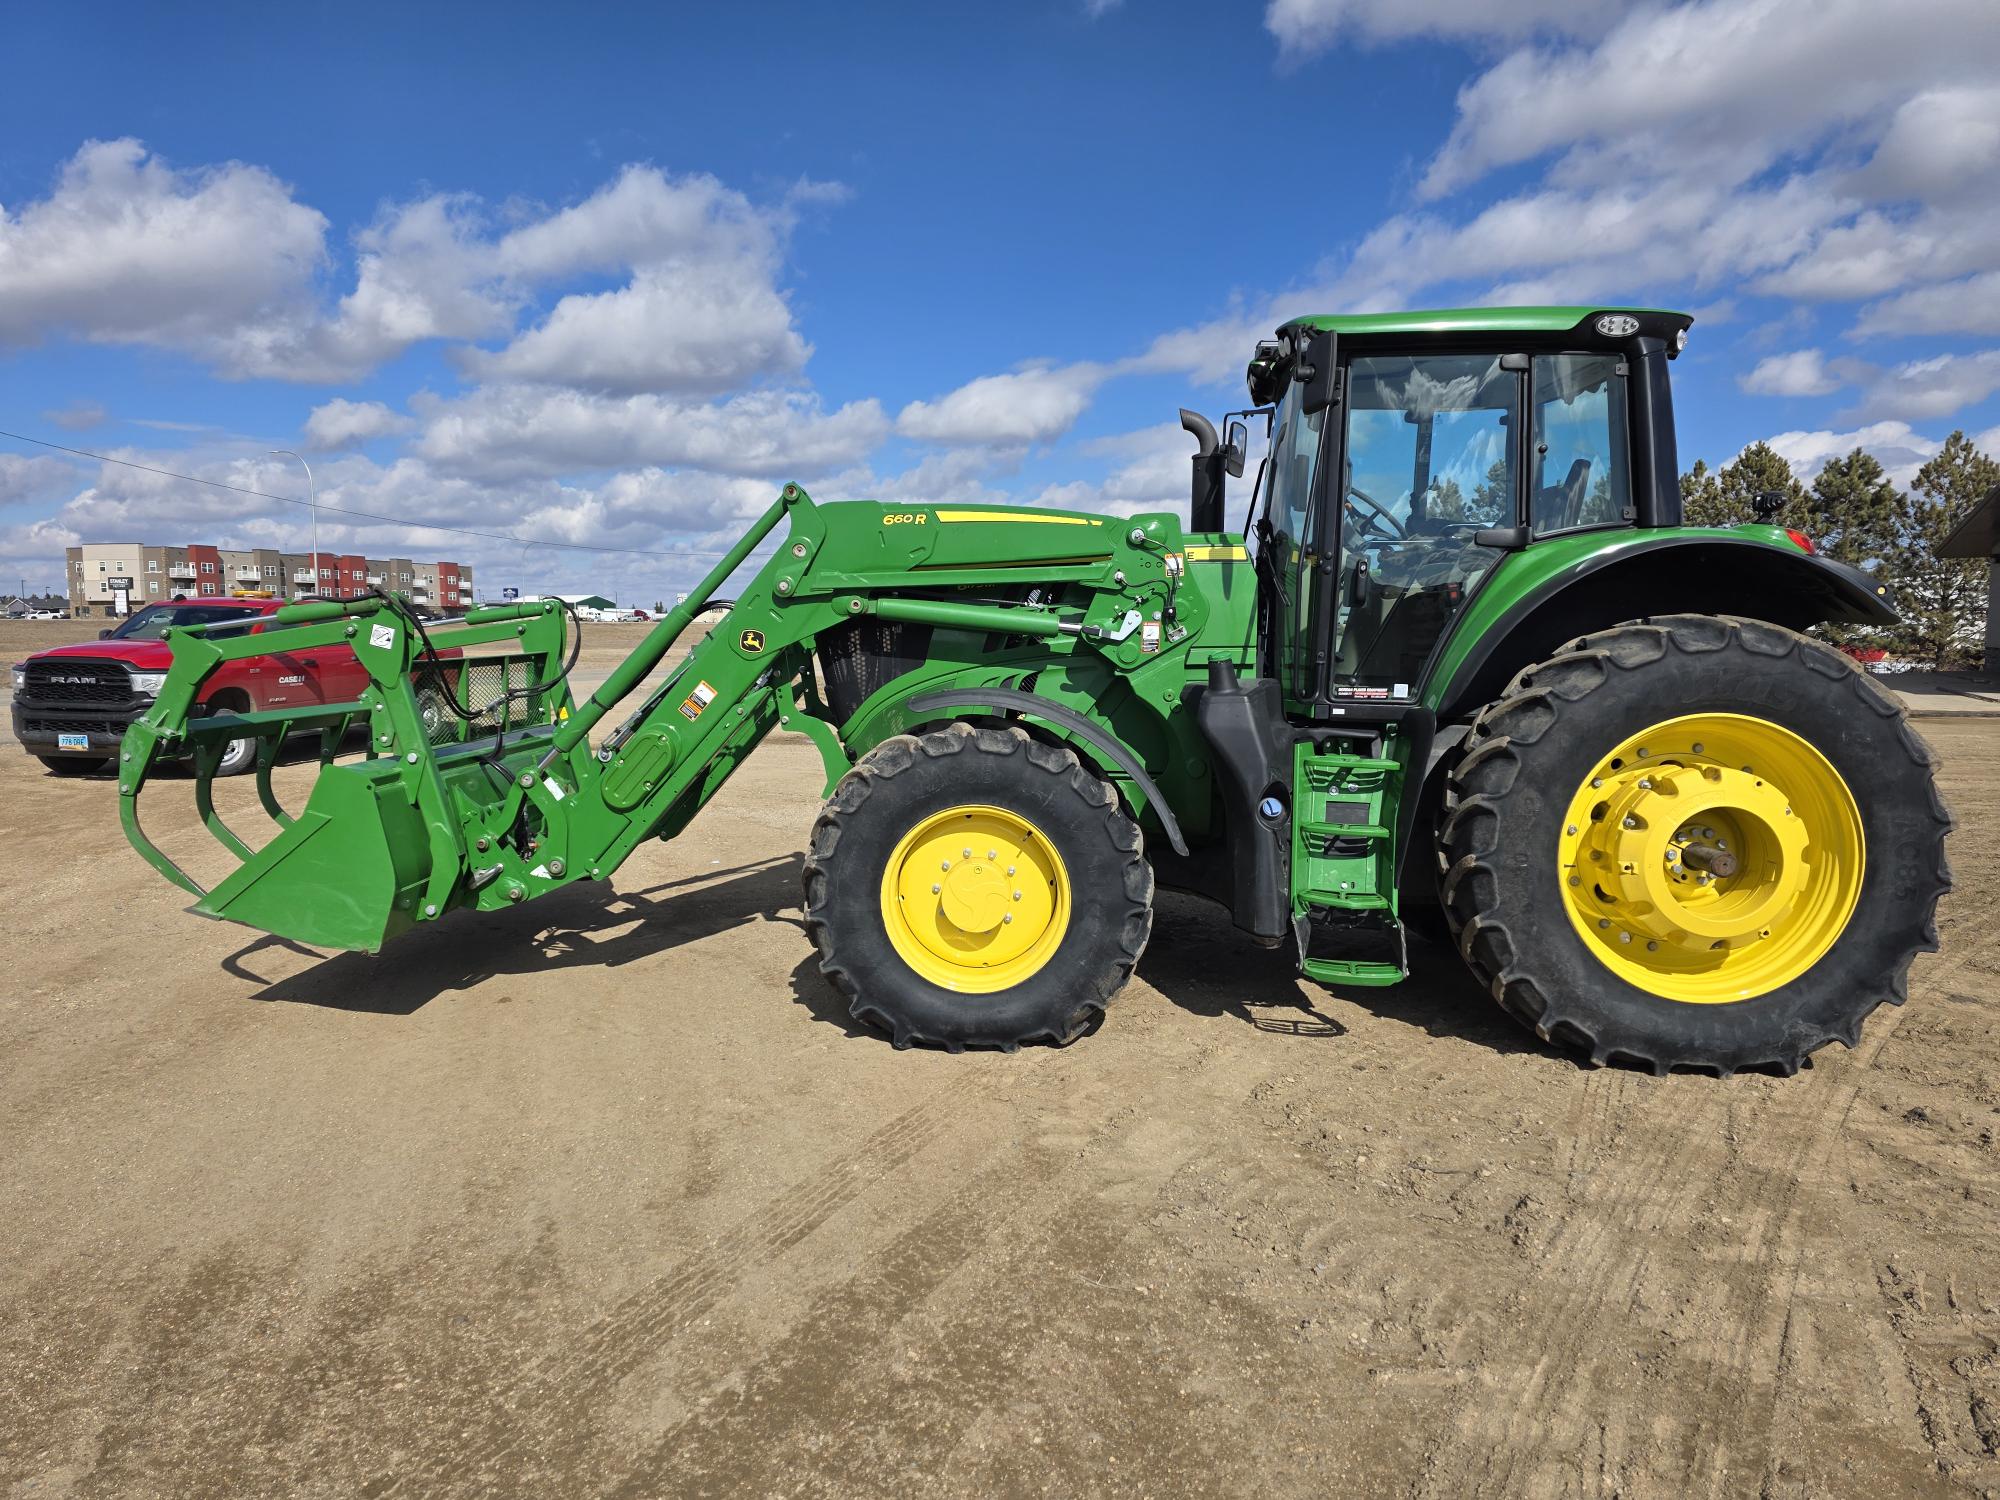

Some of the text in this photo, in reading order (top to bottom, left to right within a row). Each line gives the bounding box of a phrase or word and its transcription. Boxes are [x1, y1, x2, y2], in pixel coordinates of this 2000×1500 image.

[883, 514, 927, 525] 660 R
[51, 676, 96, 684] RAM
[278, 676, 298, 684] CASE
